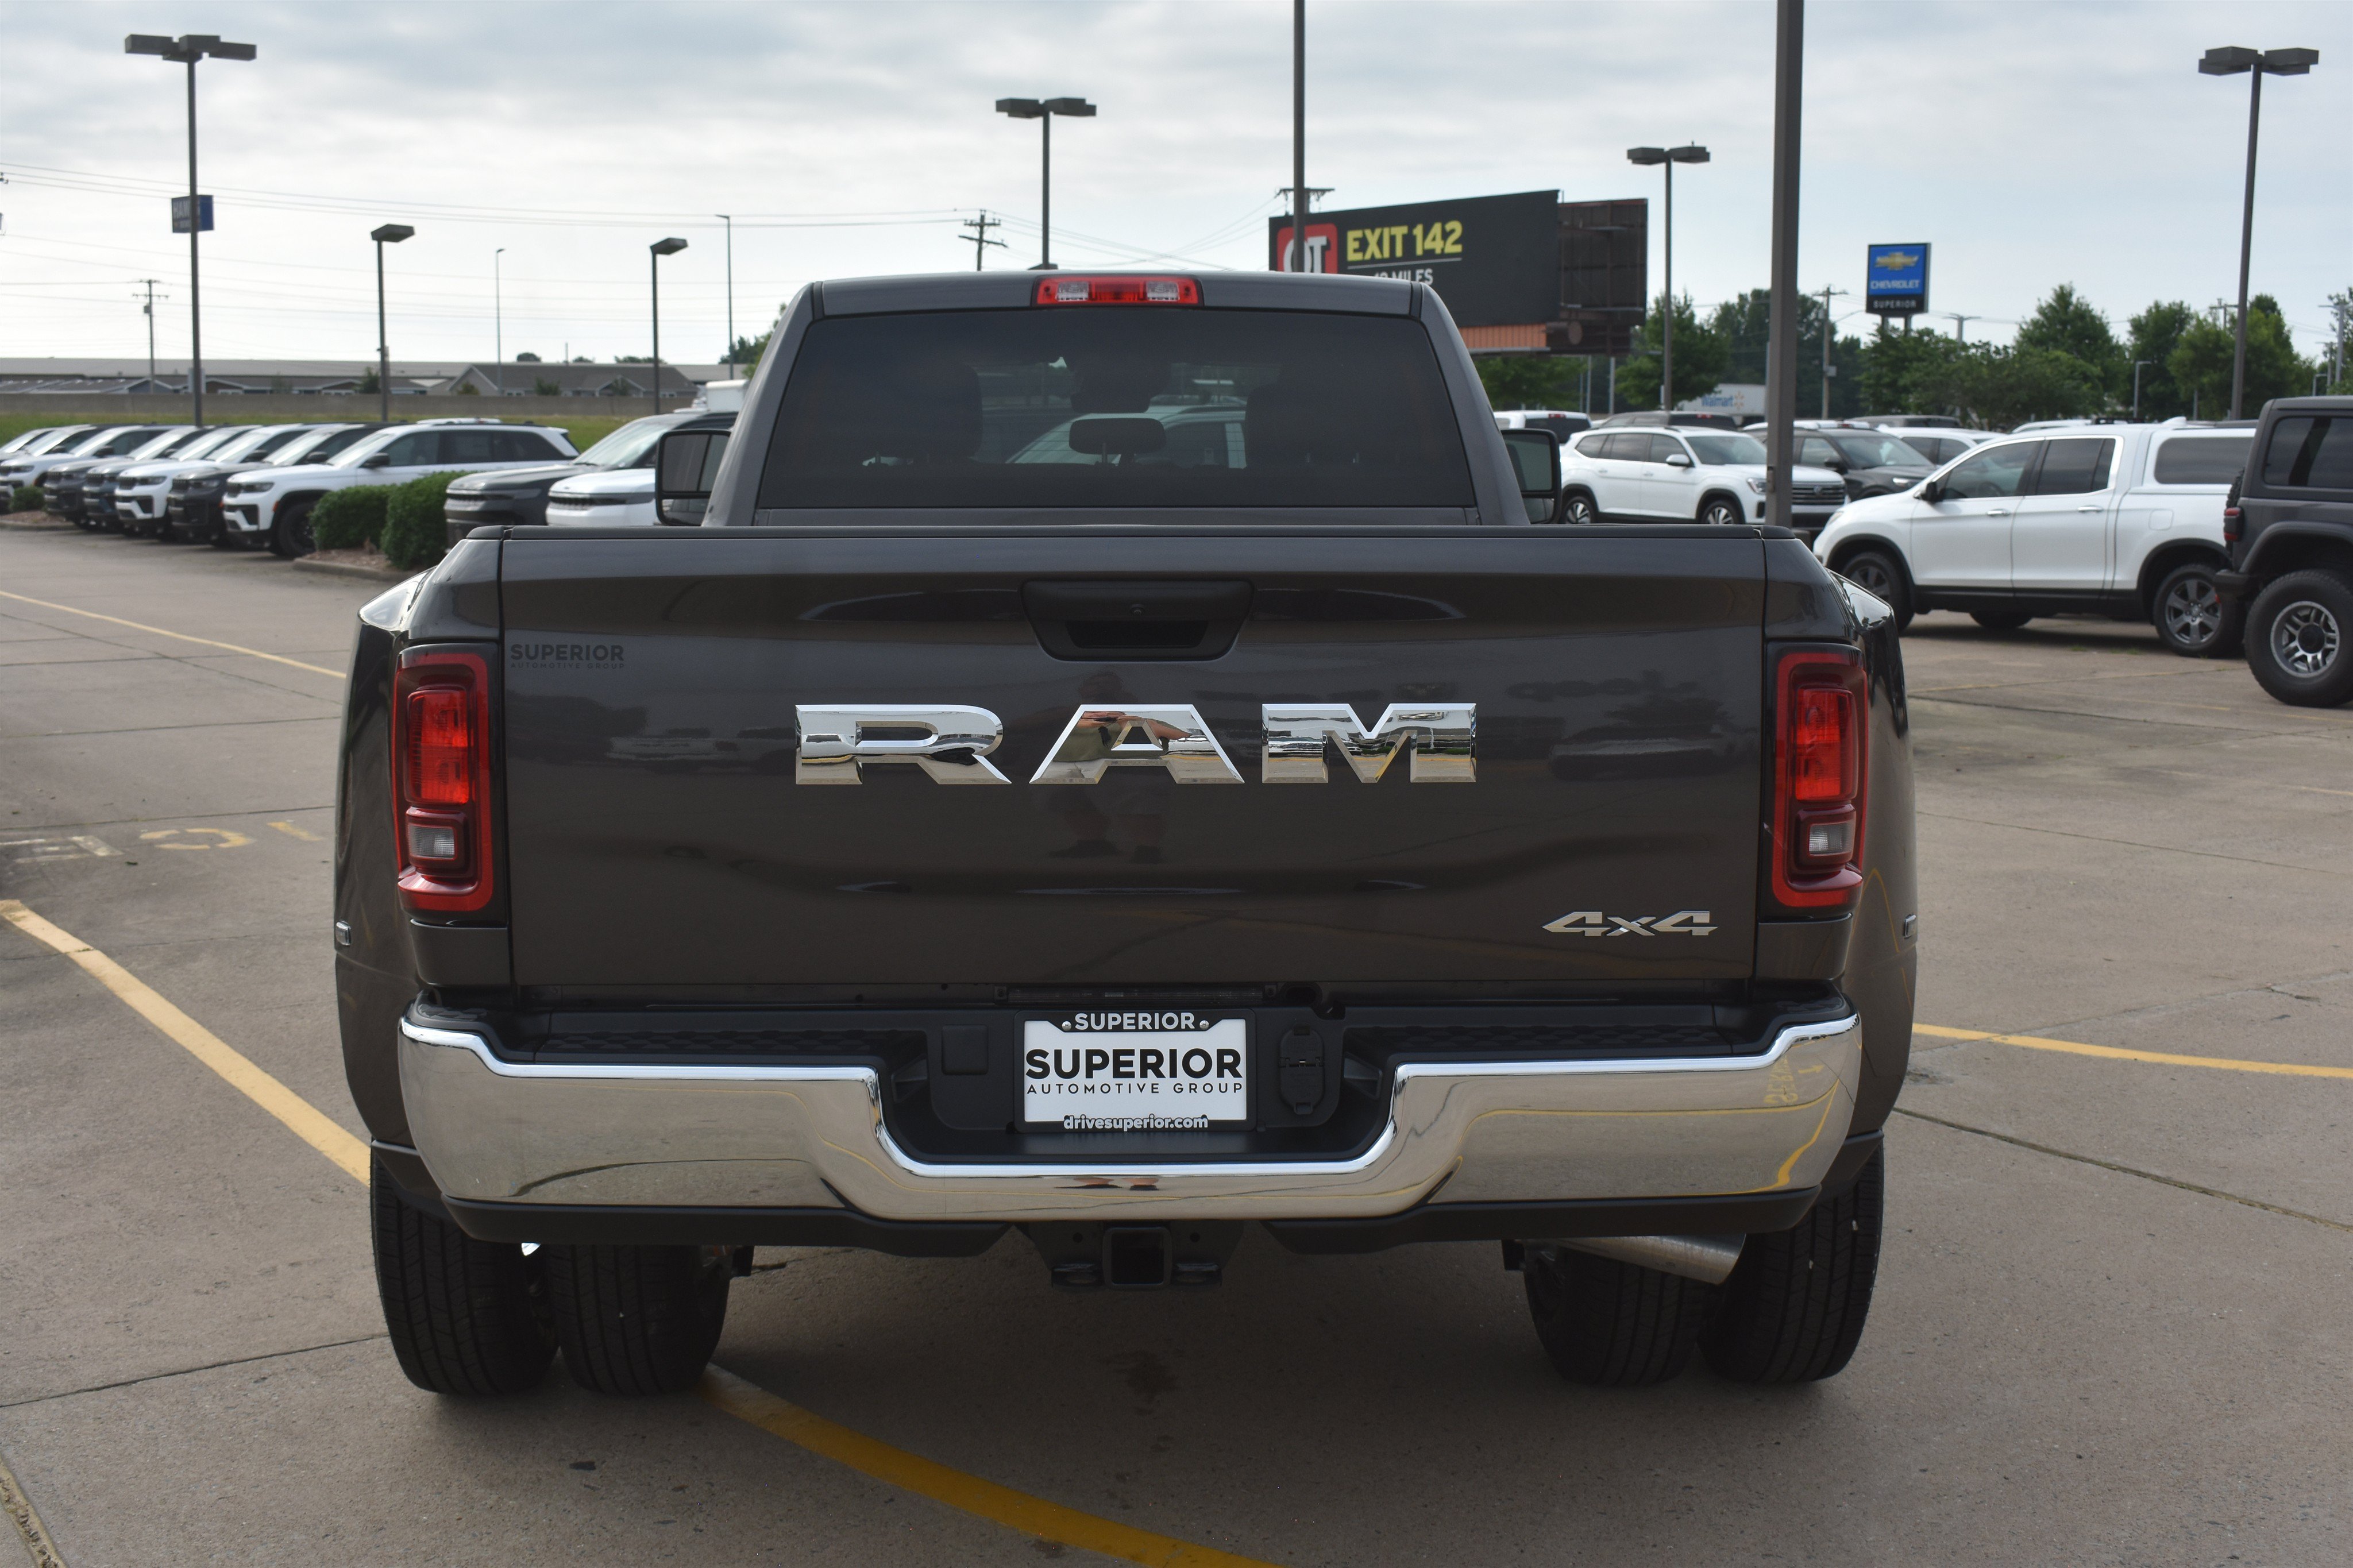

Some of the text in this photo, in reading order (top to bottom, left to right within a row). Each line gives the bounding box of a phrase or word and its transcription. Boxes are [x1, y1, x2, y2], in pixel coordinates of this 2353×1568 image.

[1347, 221, 1463, 262] EXIT 142
[1870, 279, 1920, 289] CHEVROLET
[1873, 299, 1917, 309] SUPERIOR
[1702, 395, 1734, 407] Walmart
[511, 644, 624, 661] SUPERIOR
[796, 704, 1477, 785] RAM
[1542, 910, 1718, 936] 4x4
[1075, 1013, 1195, 1030] SUPERIOR
[1025, 1048, 1243, 1079] SUPERIOR
[1027, 1083, 1243, 1094] AUTOMOTIVE GROUP
[1063, 1114, 1208, 1132] drivesuperior.com
